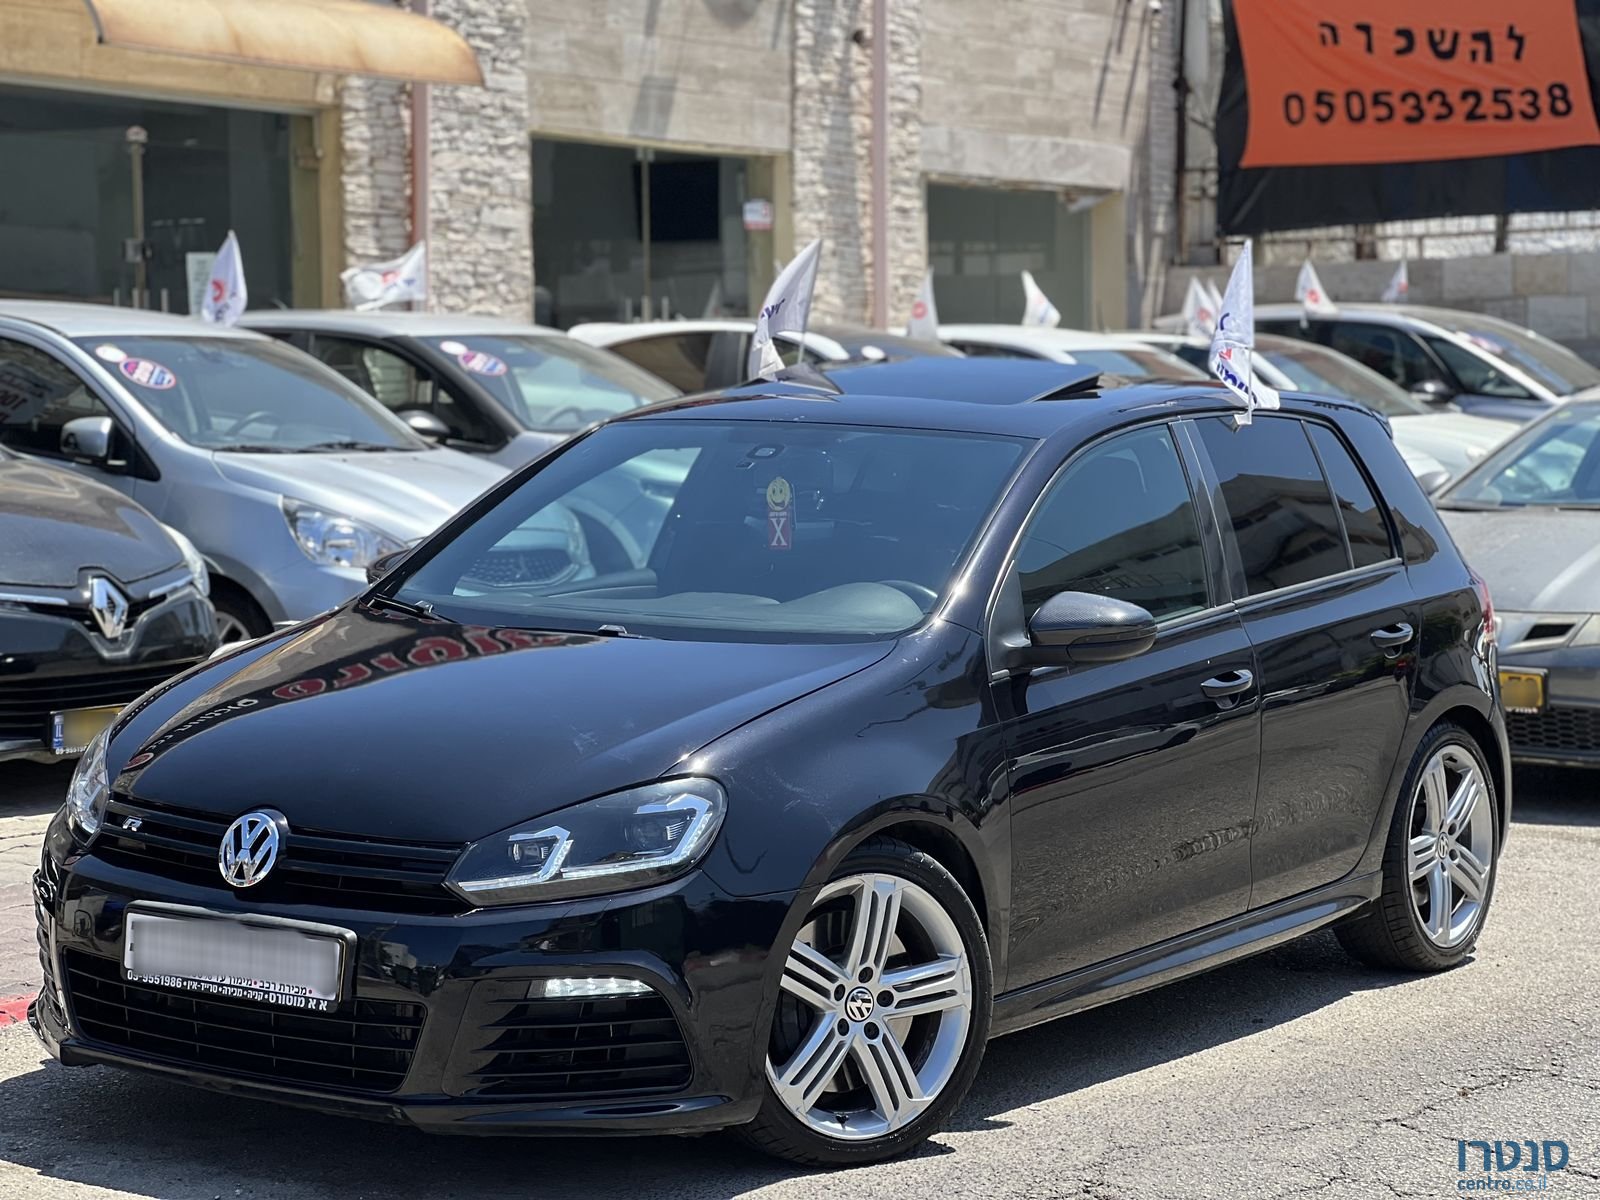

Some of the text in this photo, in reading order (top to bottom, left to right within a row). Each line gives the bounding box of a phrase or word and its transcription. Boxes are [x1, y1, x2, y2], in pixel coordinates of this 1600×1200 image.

[1318, 22, 1525, 62] להשכרה
[1284, 83, 1573, 126] 0505332538
[122, 815, 143, 832] R
[269, 992, 306, 1008] מוטורס
[307, 998, 316, 1010] א
[319, 1000, 328, 1011] א
